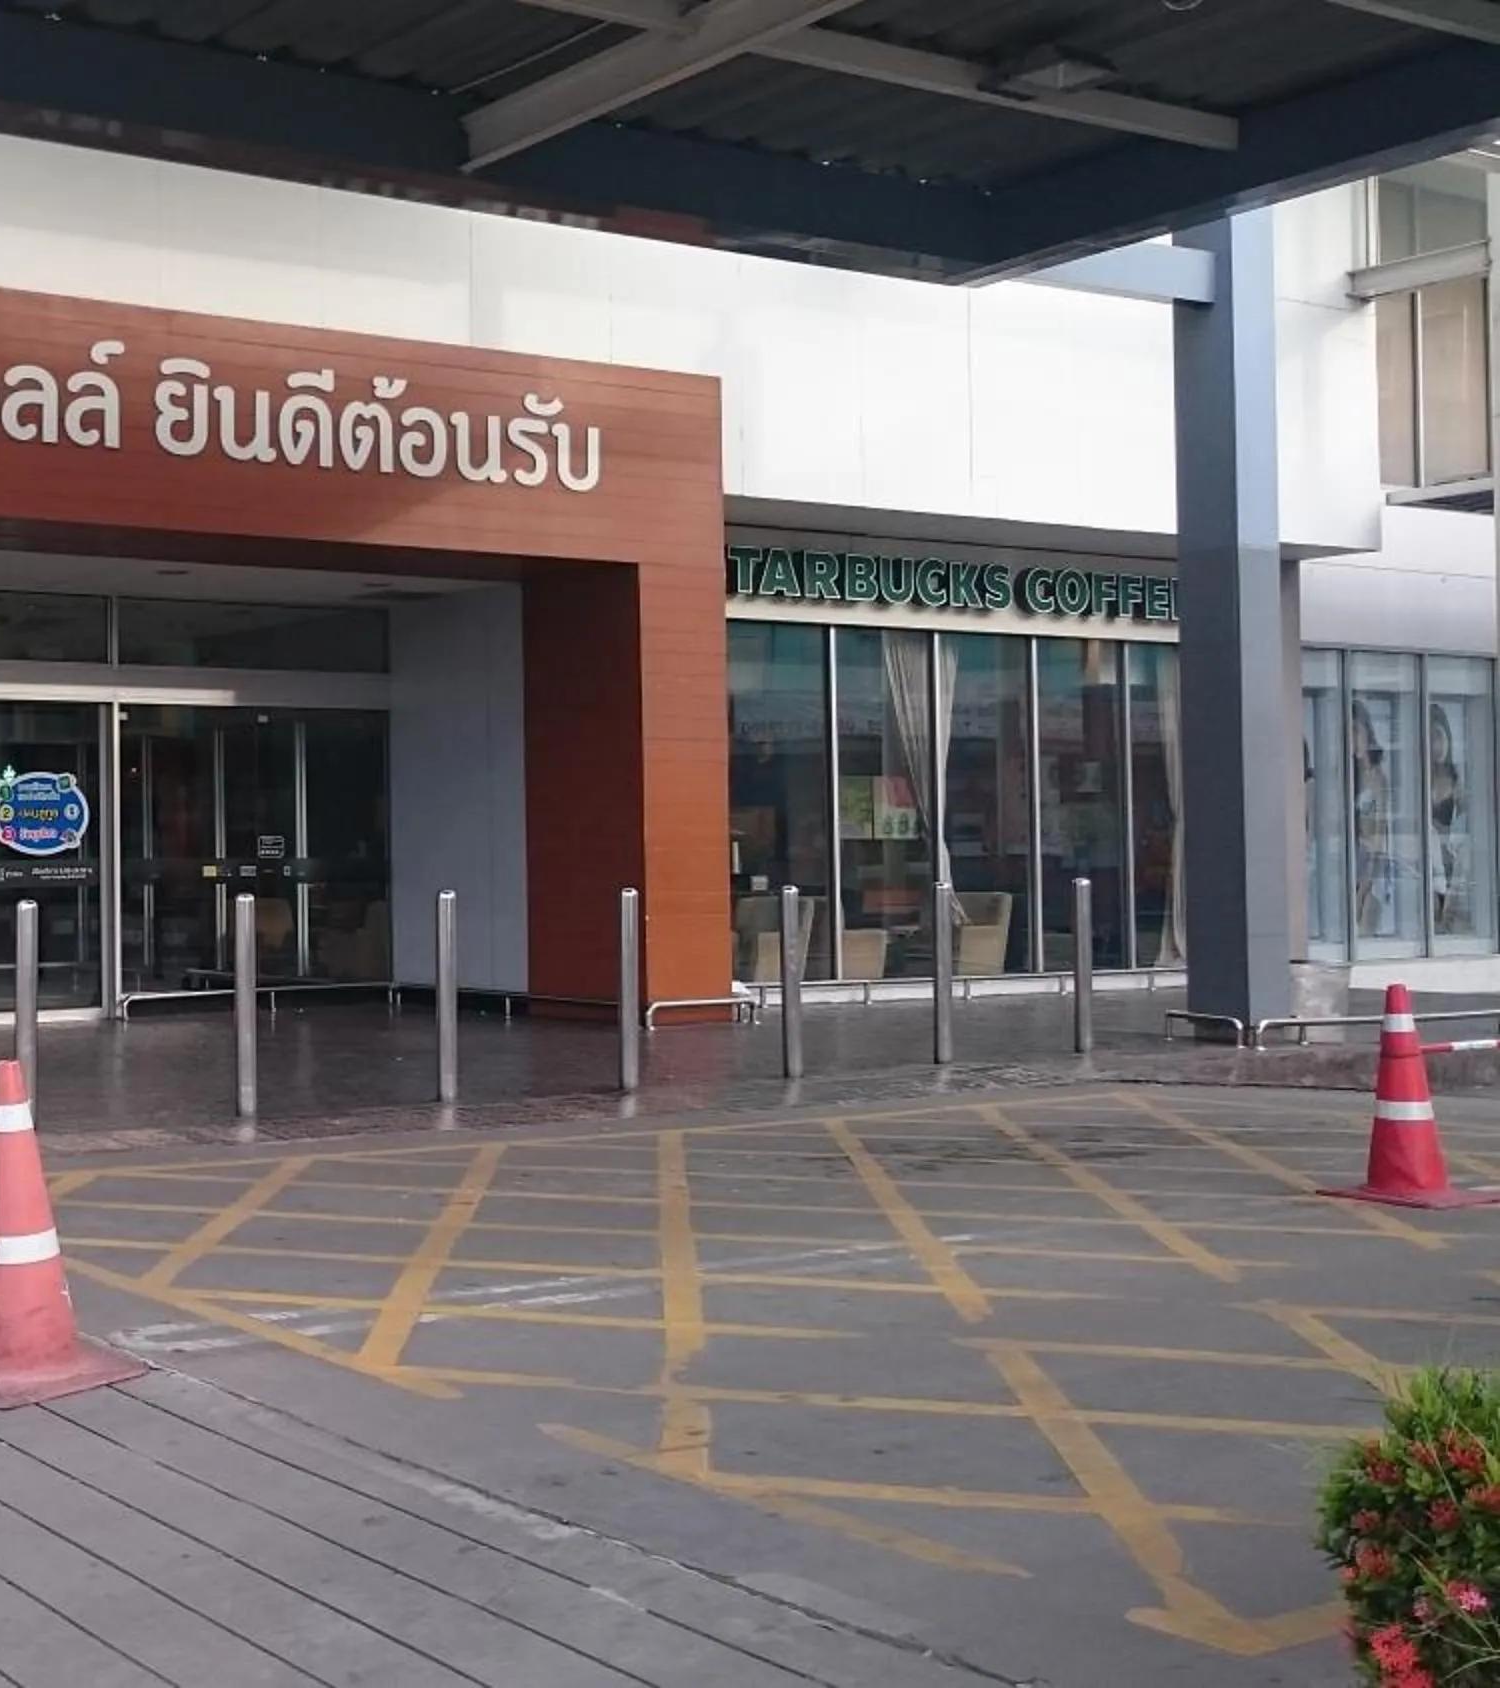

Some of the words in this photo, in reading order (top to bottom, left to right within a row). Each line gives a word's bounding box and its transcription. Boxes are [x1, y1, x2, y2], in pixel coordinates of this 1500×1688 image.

[154, 357, 600, 492] ยินดีต้อนรับ
[726, 544, 1013, 610] TARBUCKS
[1025, 566, 1180, 621] COFFE
